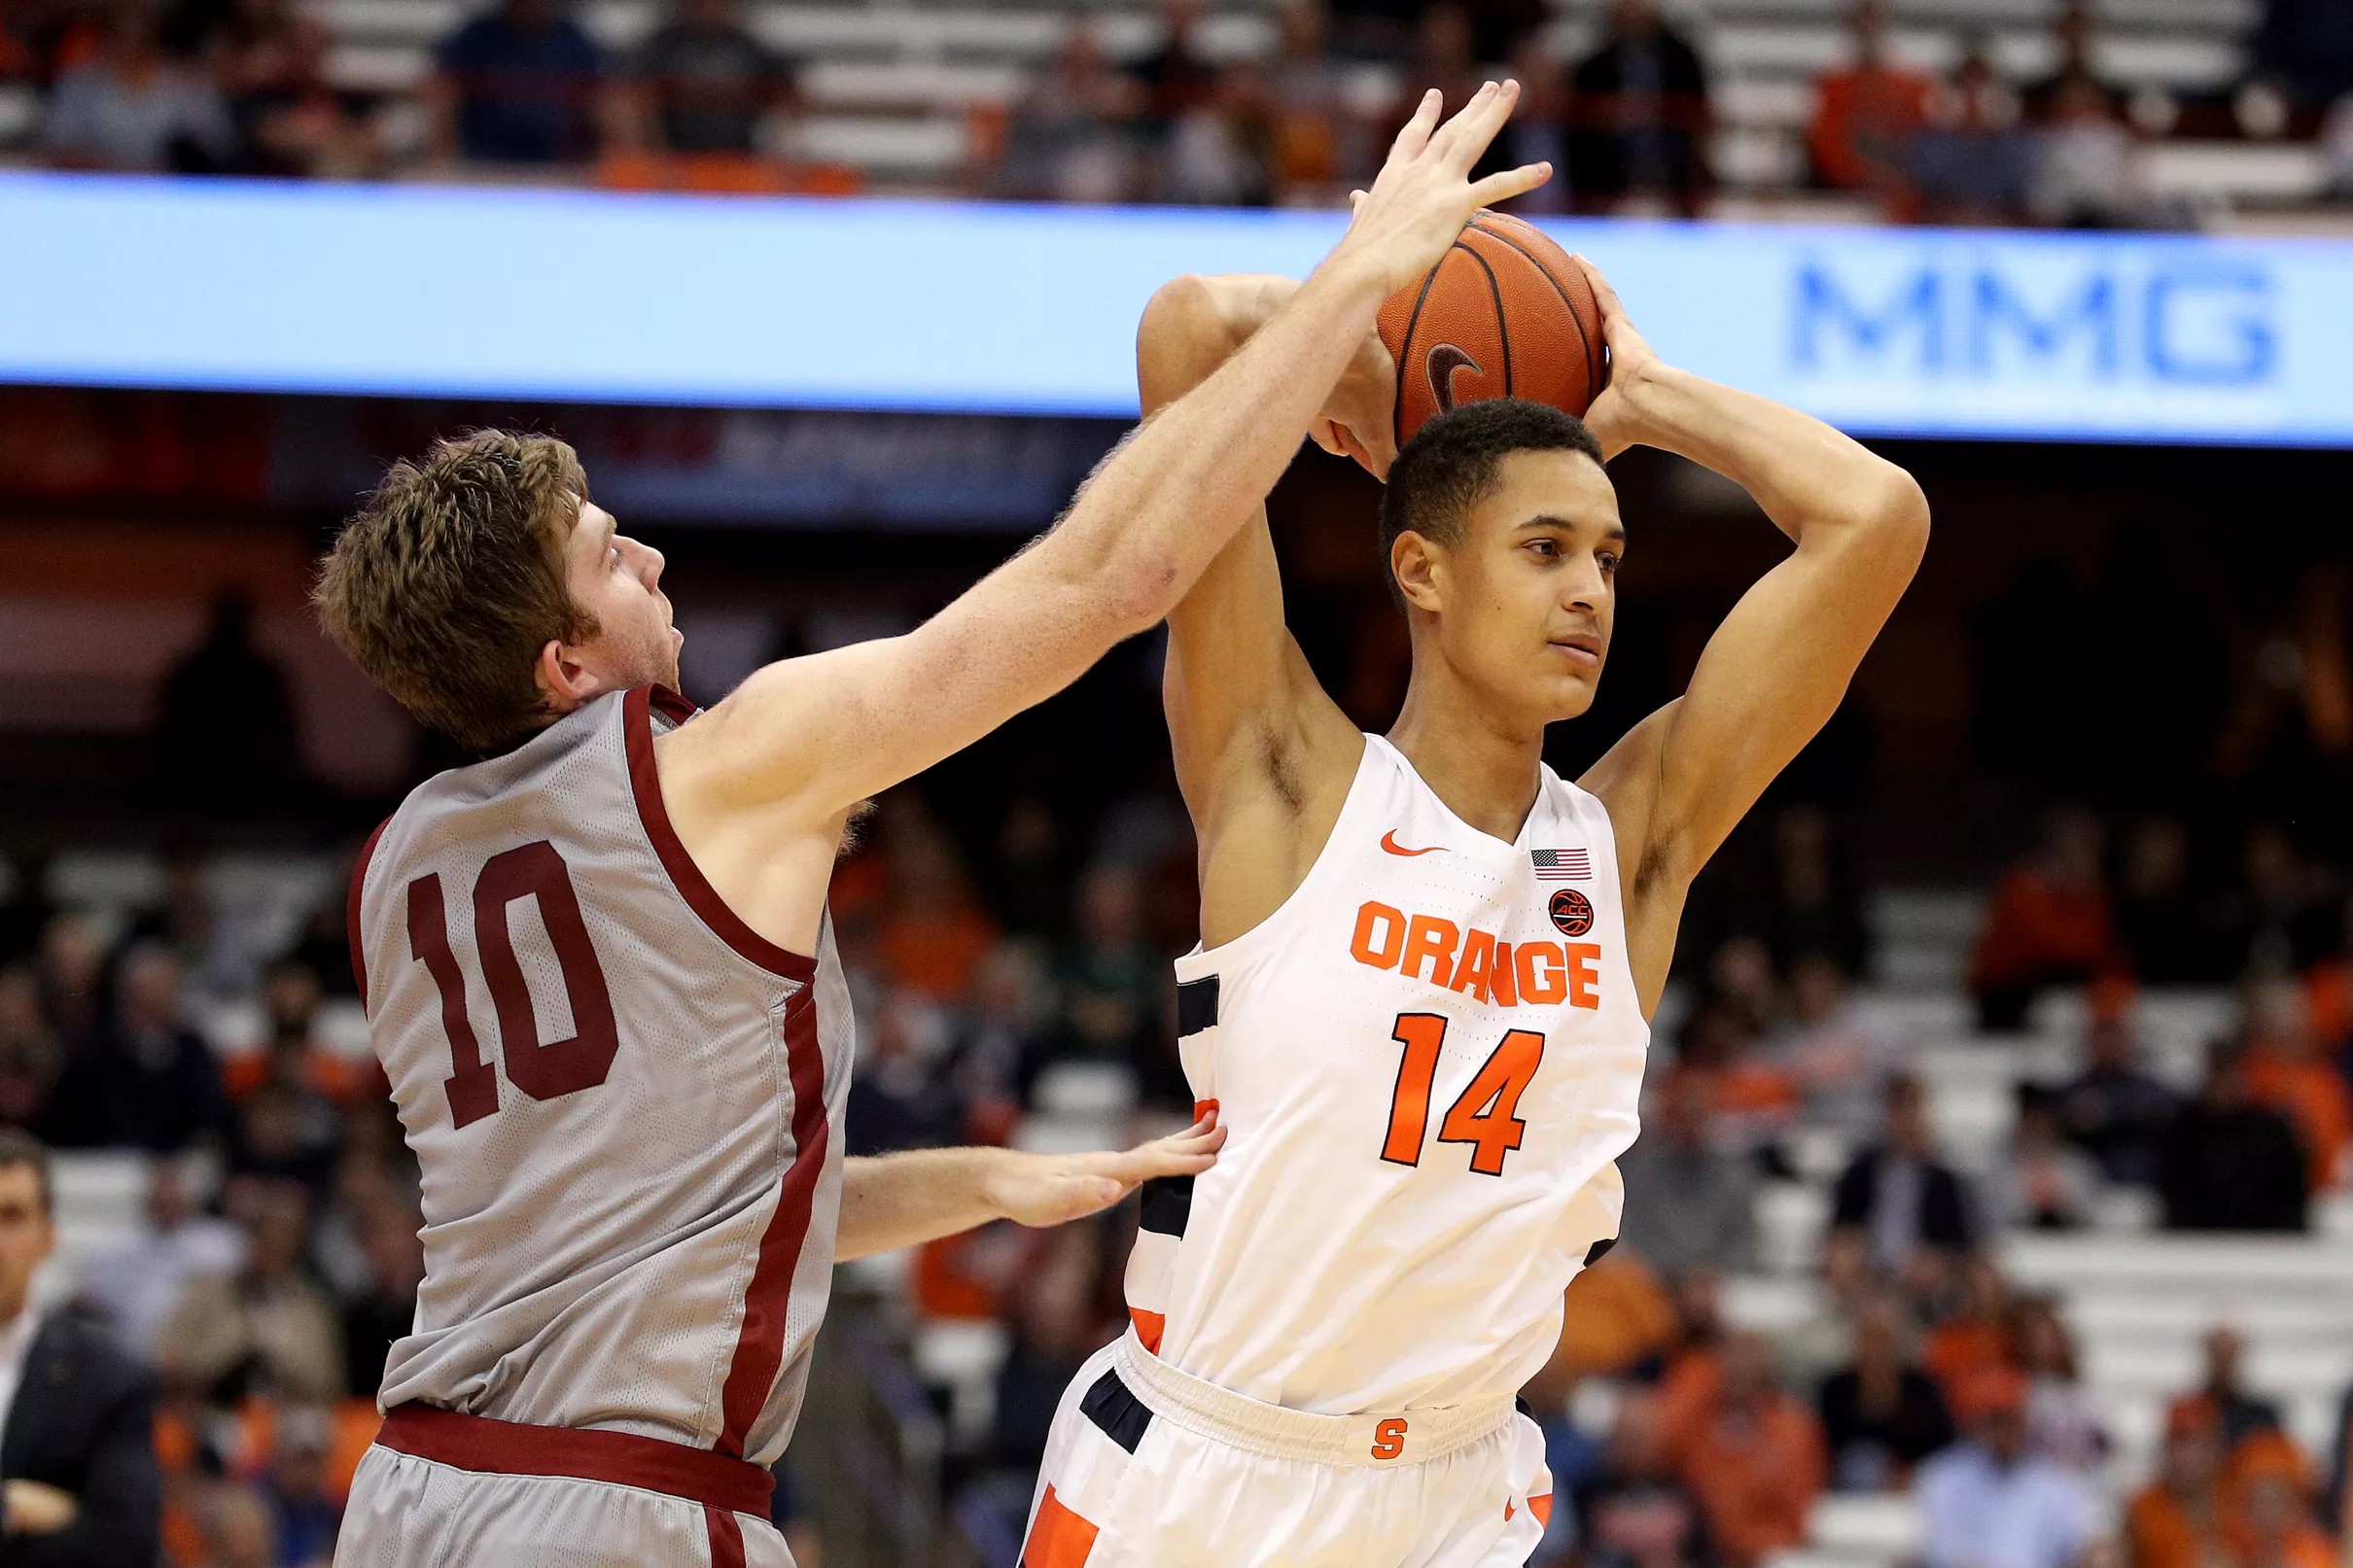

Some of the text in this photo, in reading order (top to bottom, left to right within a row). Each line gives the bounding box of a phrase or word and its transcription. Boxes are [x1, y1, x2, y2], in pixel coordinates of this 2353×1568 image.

[1791, 261, 2279, 385] MMG
[1351, 901, 1600, 1010] ORANGE
[1556, 904, 1589, 915] ACC
[406, 840, 619, 1131] 10
[1381, 1013, 1545, 1176] 14
[1372, 1418, 1408, 1459] S
